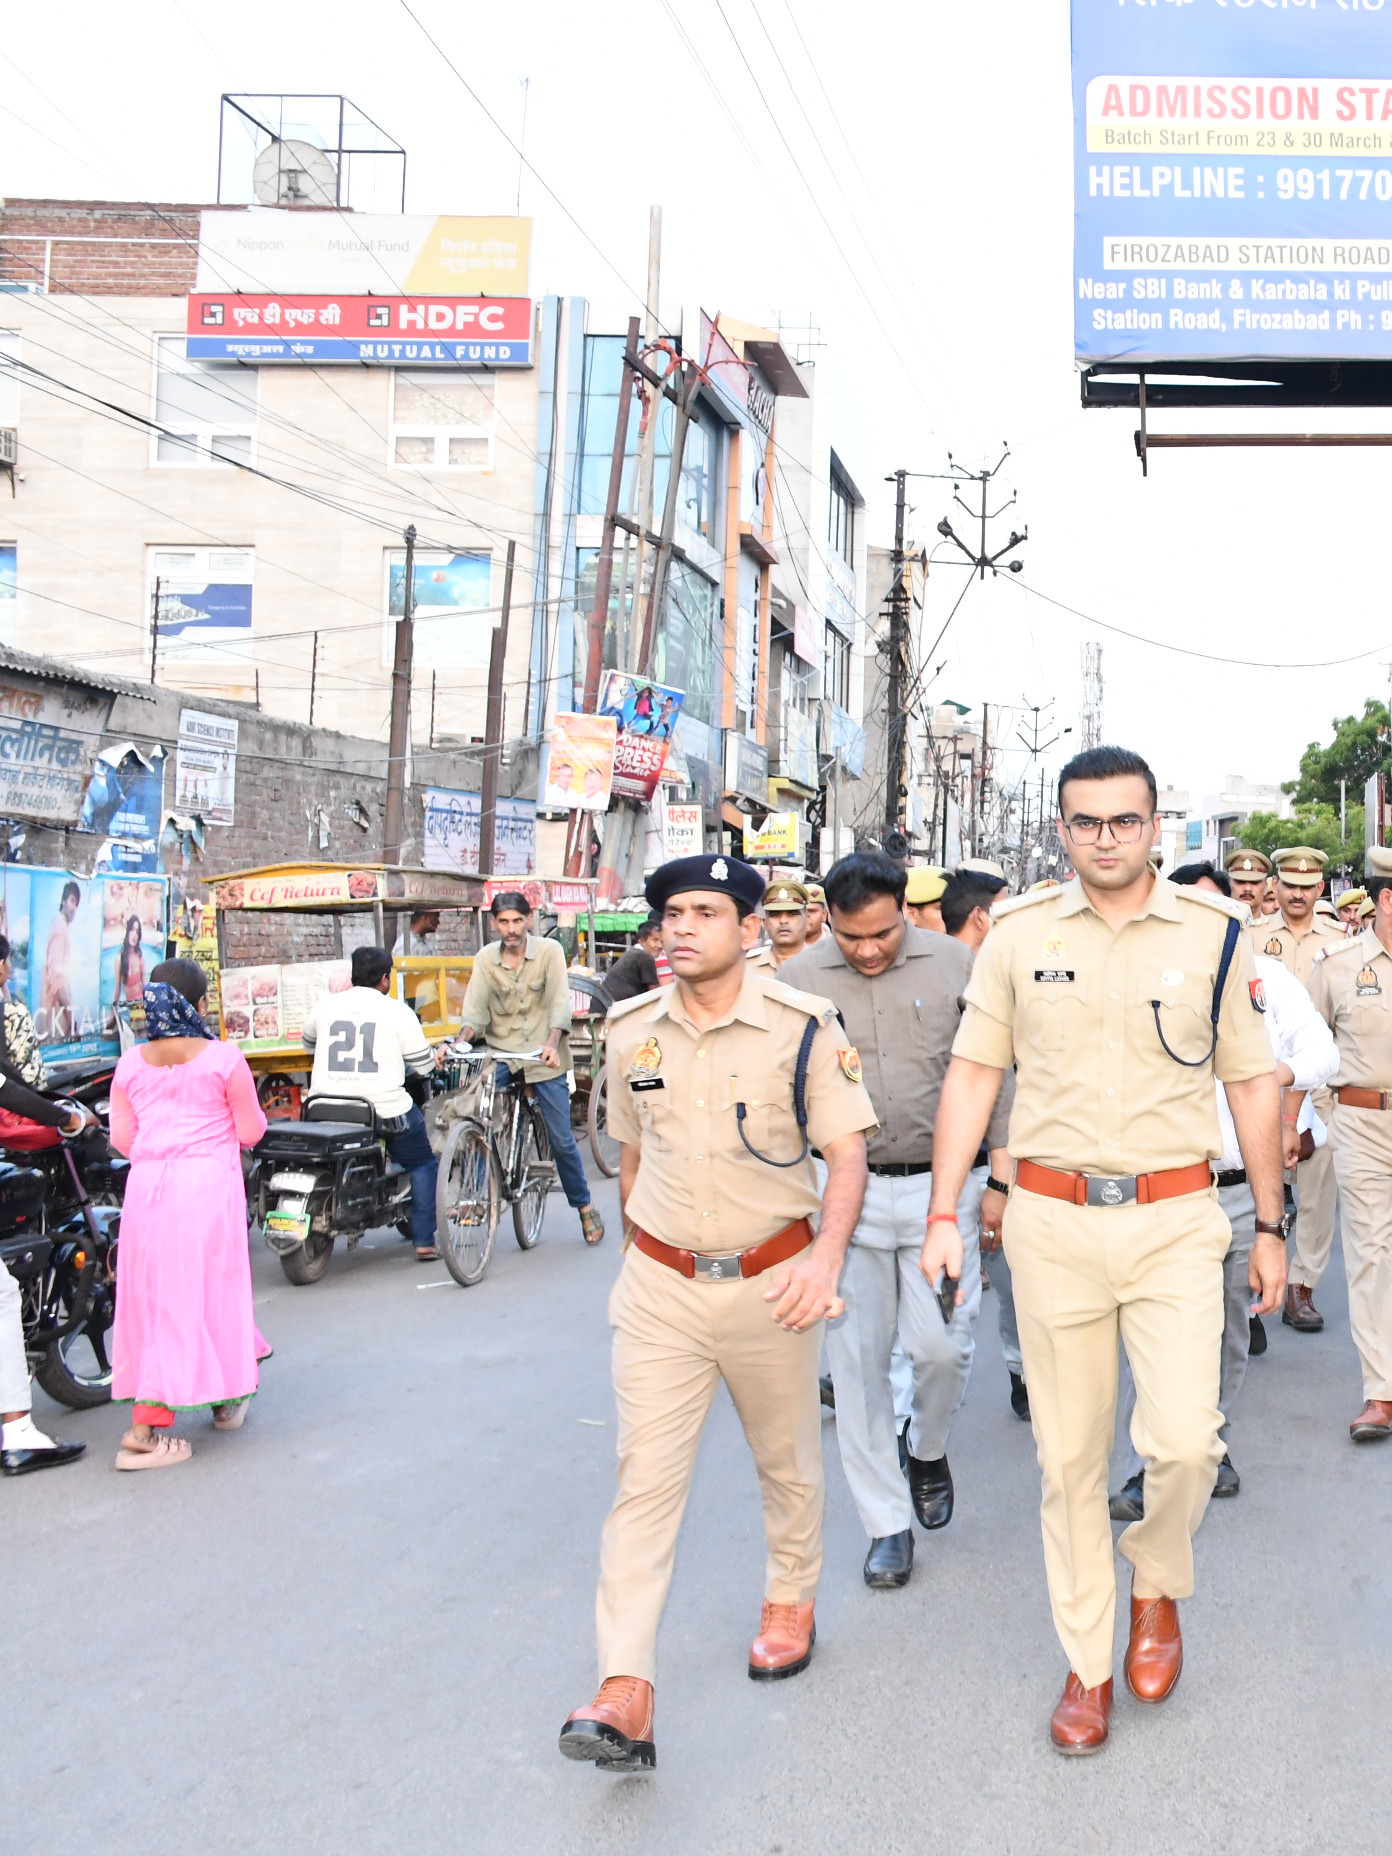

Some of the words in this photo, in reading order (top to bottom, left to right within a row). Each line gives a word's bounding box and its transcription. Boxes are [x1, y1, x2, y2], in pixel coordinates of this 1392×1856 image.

[1101, 83, 1319, 120] ADMISSION
[1105, 129, 1154, 146] Batch
[1160, 130, 1200, 147] Start
[1207, 131, 1249, 147] From
[1256, 132, 1276, 147] 23
[1284, 132, 1295, 148] &
[1302, 132, 1323, 148] 30
[1330, 132, 1383, 149] March
[1089, 166, 1245, 198] HELPLINE
[237, 238, 284, 251] Nippon
[328, 239, 373, 251] Mutual
[378, 239, 410, 252] Fund
[1111, 244, 1230, 264] FIROZABAD
[1239, 245, 1324, 265] STATION
[1333, 246, 1391, 266] ROAD
[1079, 278, 1126, 299] Near
[1133, 279, 1166, 300] SBI
[1173, 279, 1221, 300] Bank
[1229, 281, 1244, 300] &
[1251, 280, 1327, 300] Karbala
[1334, 281, 1350, 301] ki
[233, 308, 259, 327] एच
[263, 303, 281, 324] डी
[285, 309, 316, 328] एफ
[319, 303, 341, 325] सी
[399, 304, 505, 330] HDFC
[1093, 309, 1163, 329] Station
[1169, 309, 1226, 332] Road,
[1233, 310, 1330, 330] Firozabad
[1336, 311, 1362, 330] Ph
[360, 343, 445, 359] MUTUAL
[455, 344, 511, 360] FUND
[0, 720, 84, 767] लीनिक
[623, 734, 661, 753] DANCE
[282, 885, 341, 900] Return
[33, 1005, 114, 1040] CKTAIL
[328, 1020, 378, 1073] 21
